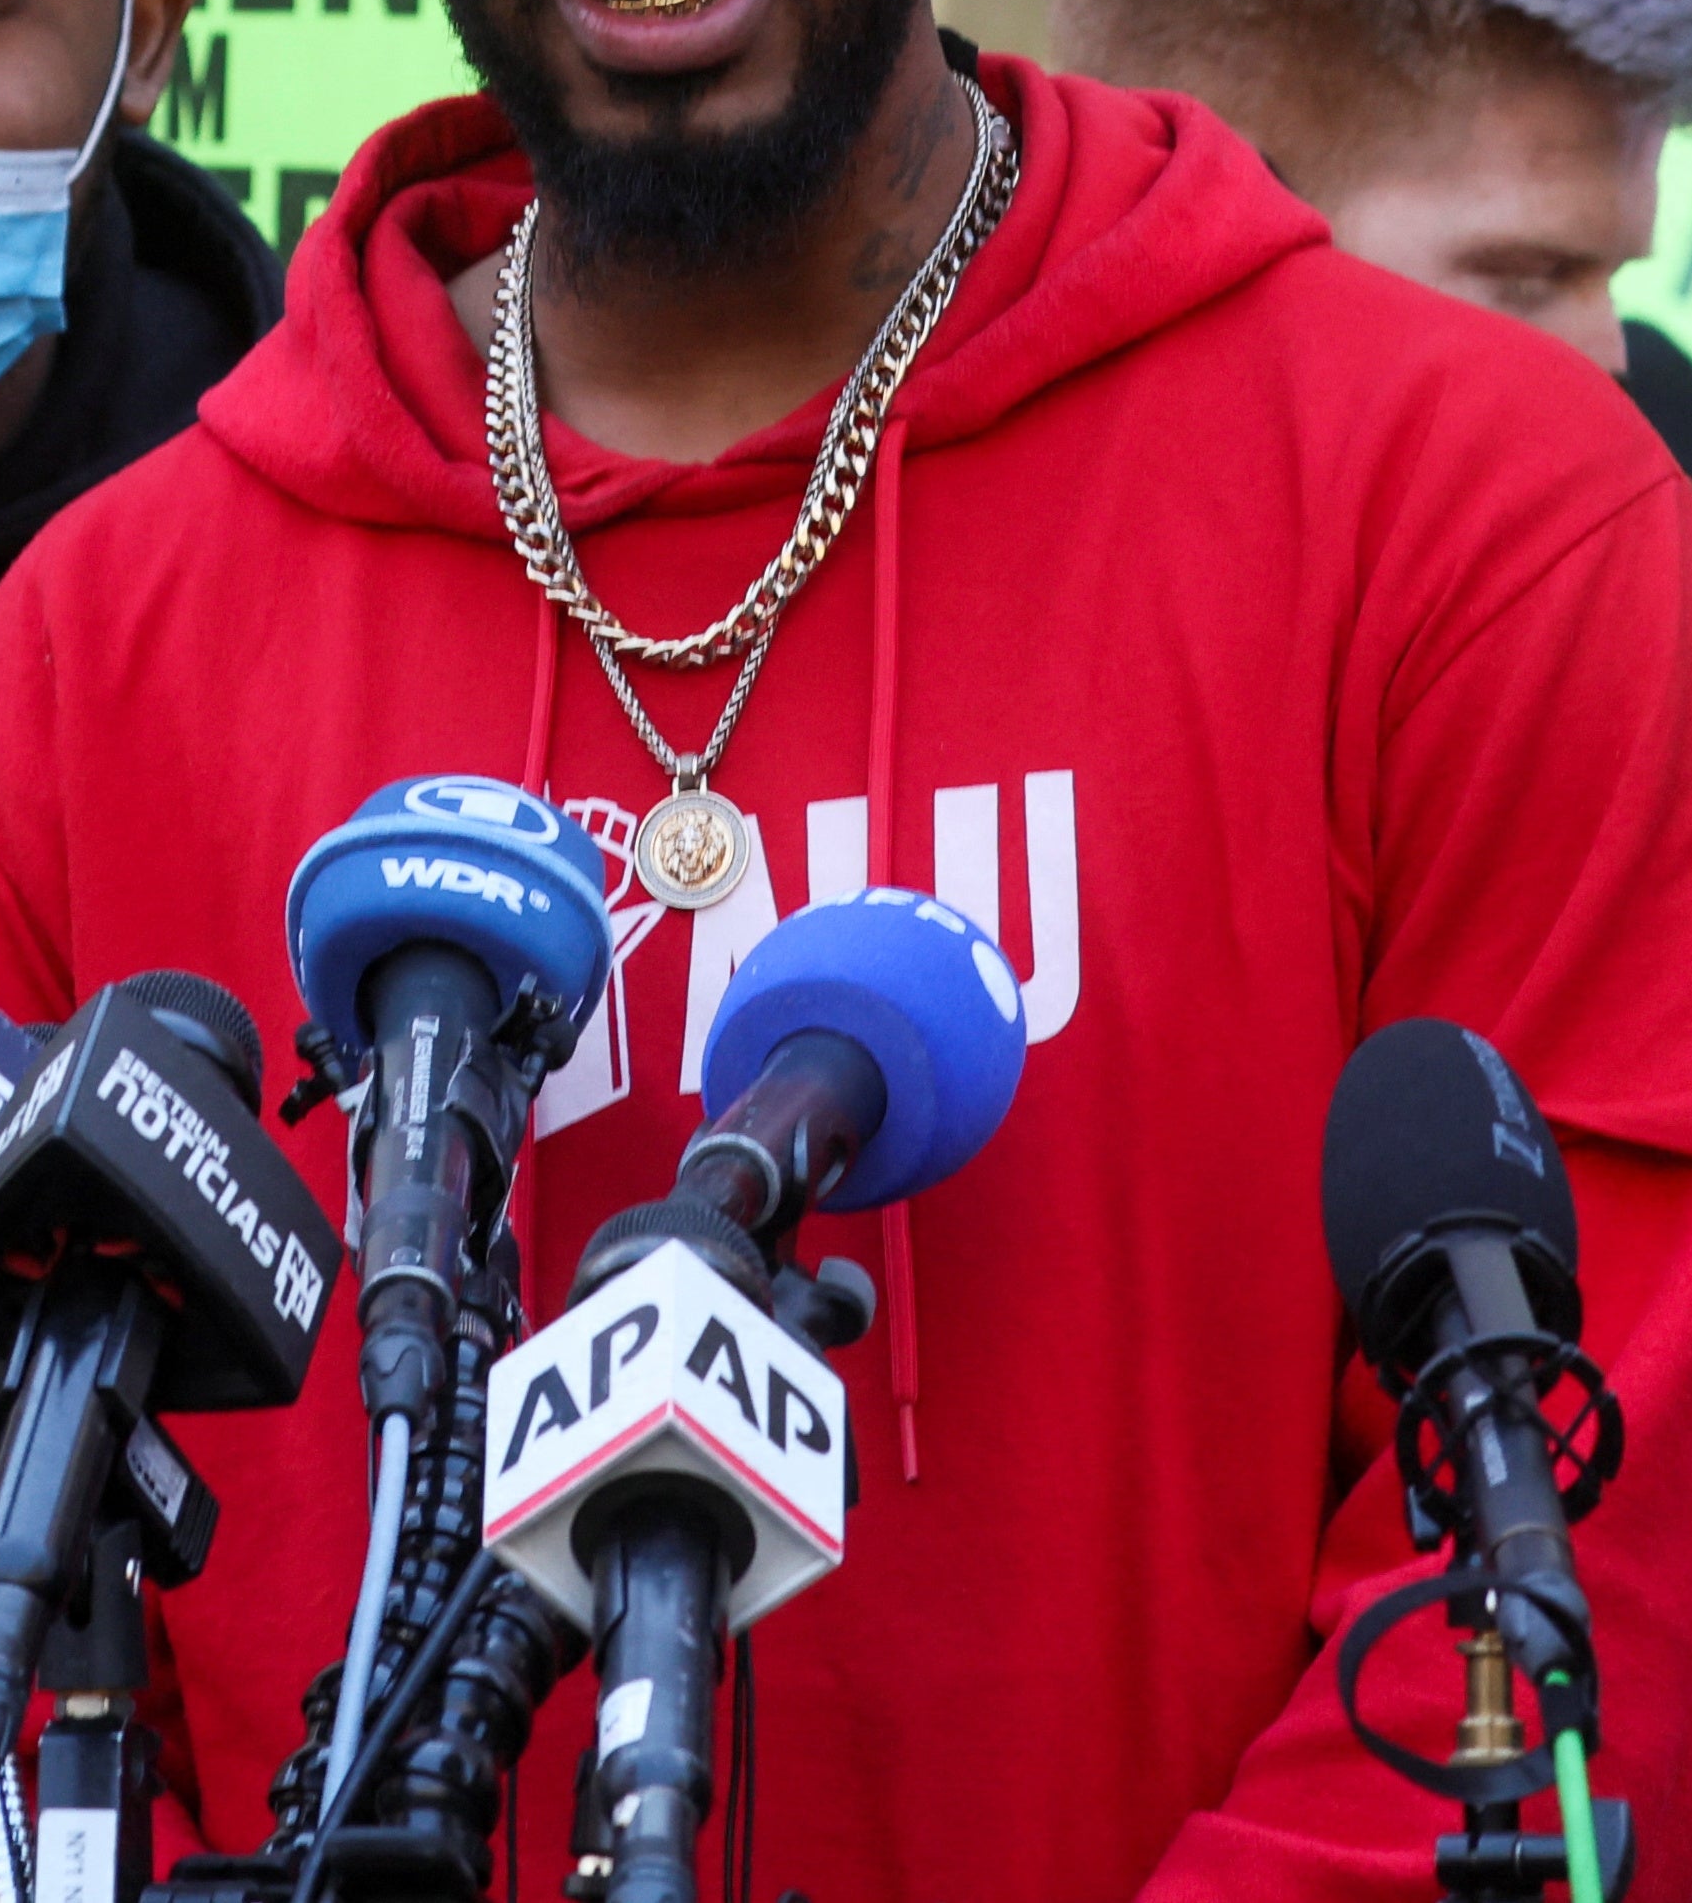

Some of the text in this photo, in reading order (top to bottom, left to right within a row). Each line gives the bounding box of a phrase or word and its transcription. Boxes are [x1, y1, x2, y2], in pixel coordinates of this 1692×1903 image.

[380, 857, 525, 916] WDR
[118, 1047, 230, 1166] SPECTRUM
[498, 1302, 660, 1479] AP
[684, 1314, 833, 1456] AP
